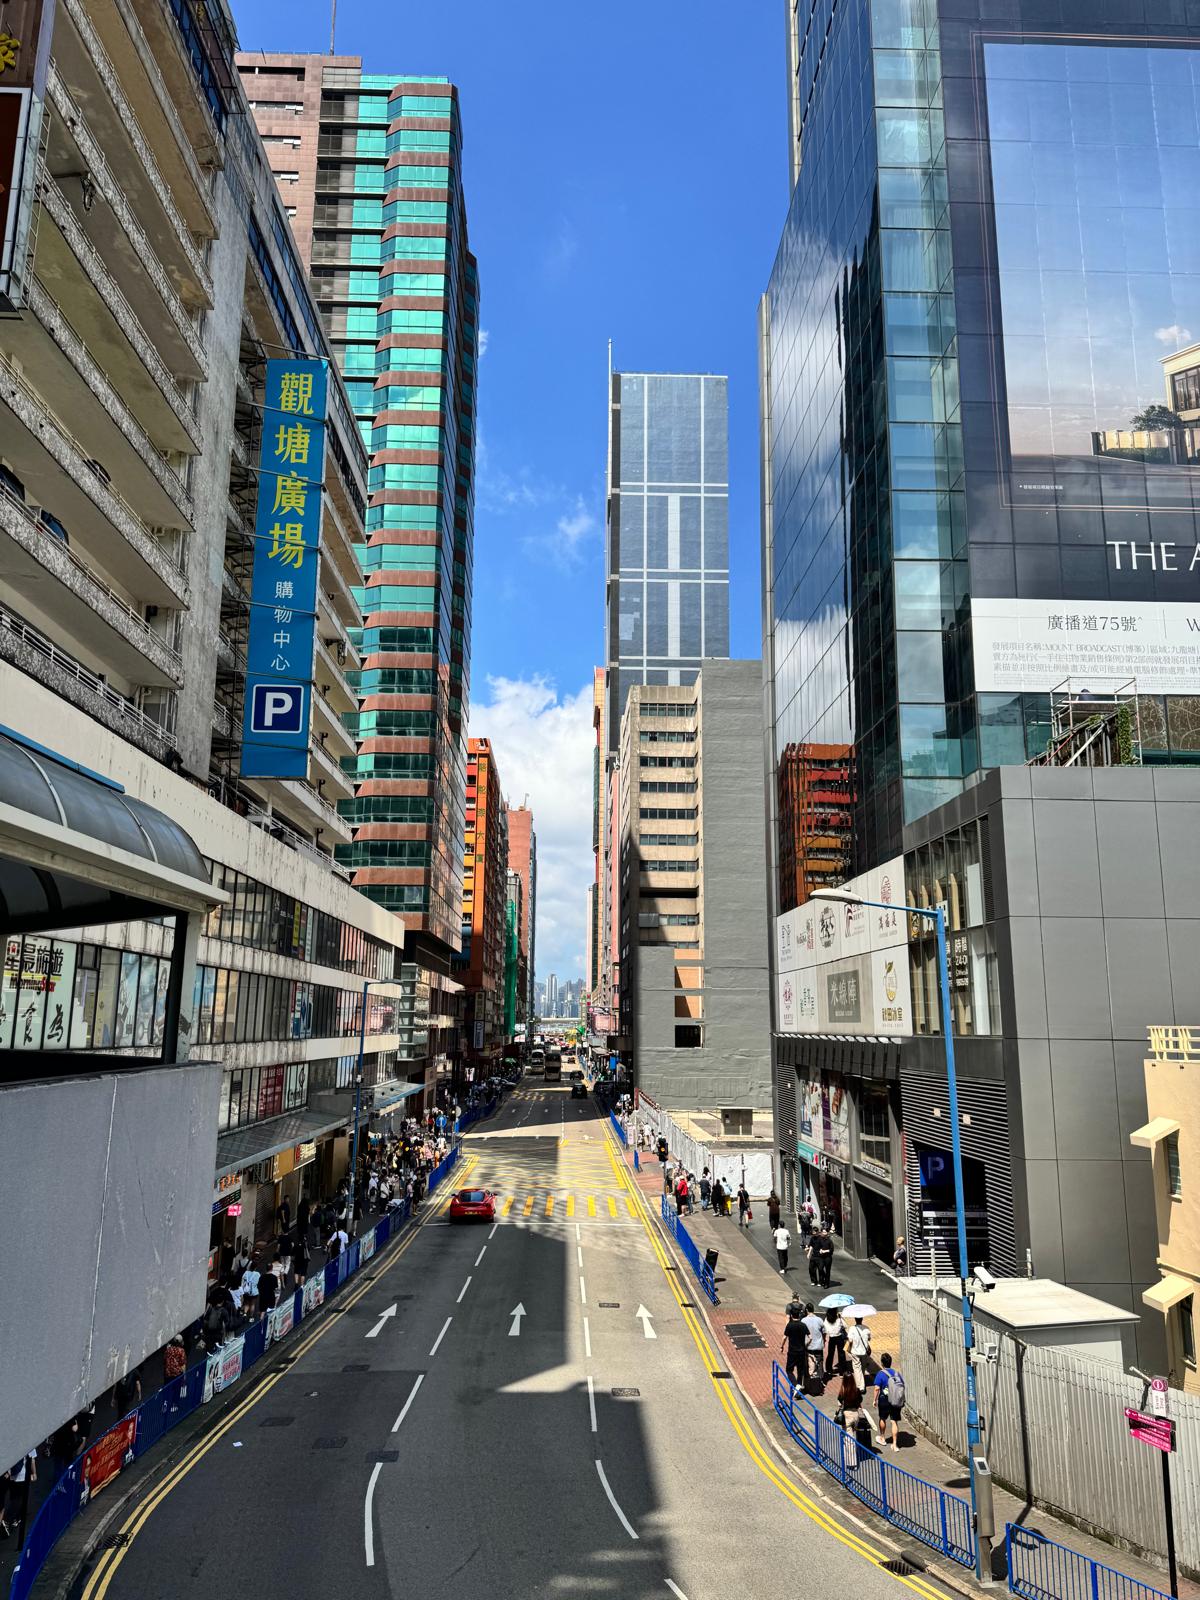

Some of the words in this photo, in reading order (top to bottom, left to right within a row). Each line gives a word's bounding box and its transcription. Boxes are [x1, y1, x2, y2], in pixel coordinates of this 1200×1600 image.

[268, 371, 315, 570] 觀塘廣場
[1106, 541, 1178, 571] THE
[270, 580, 294, 672] 購物中心
[262, 692, 294, 728] P
[927, 1156, 945, 1180] P
